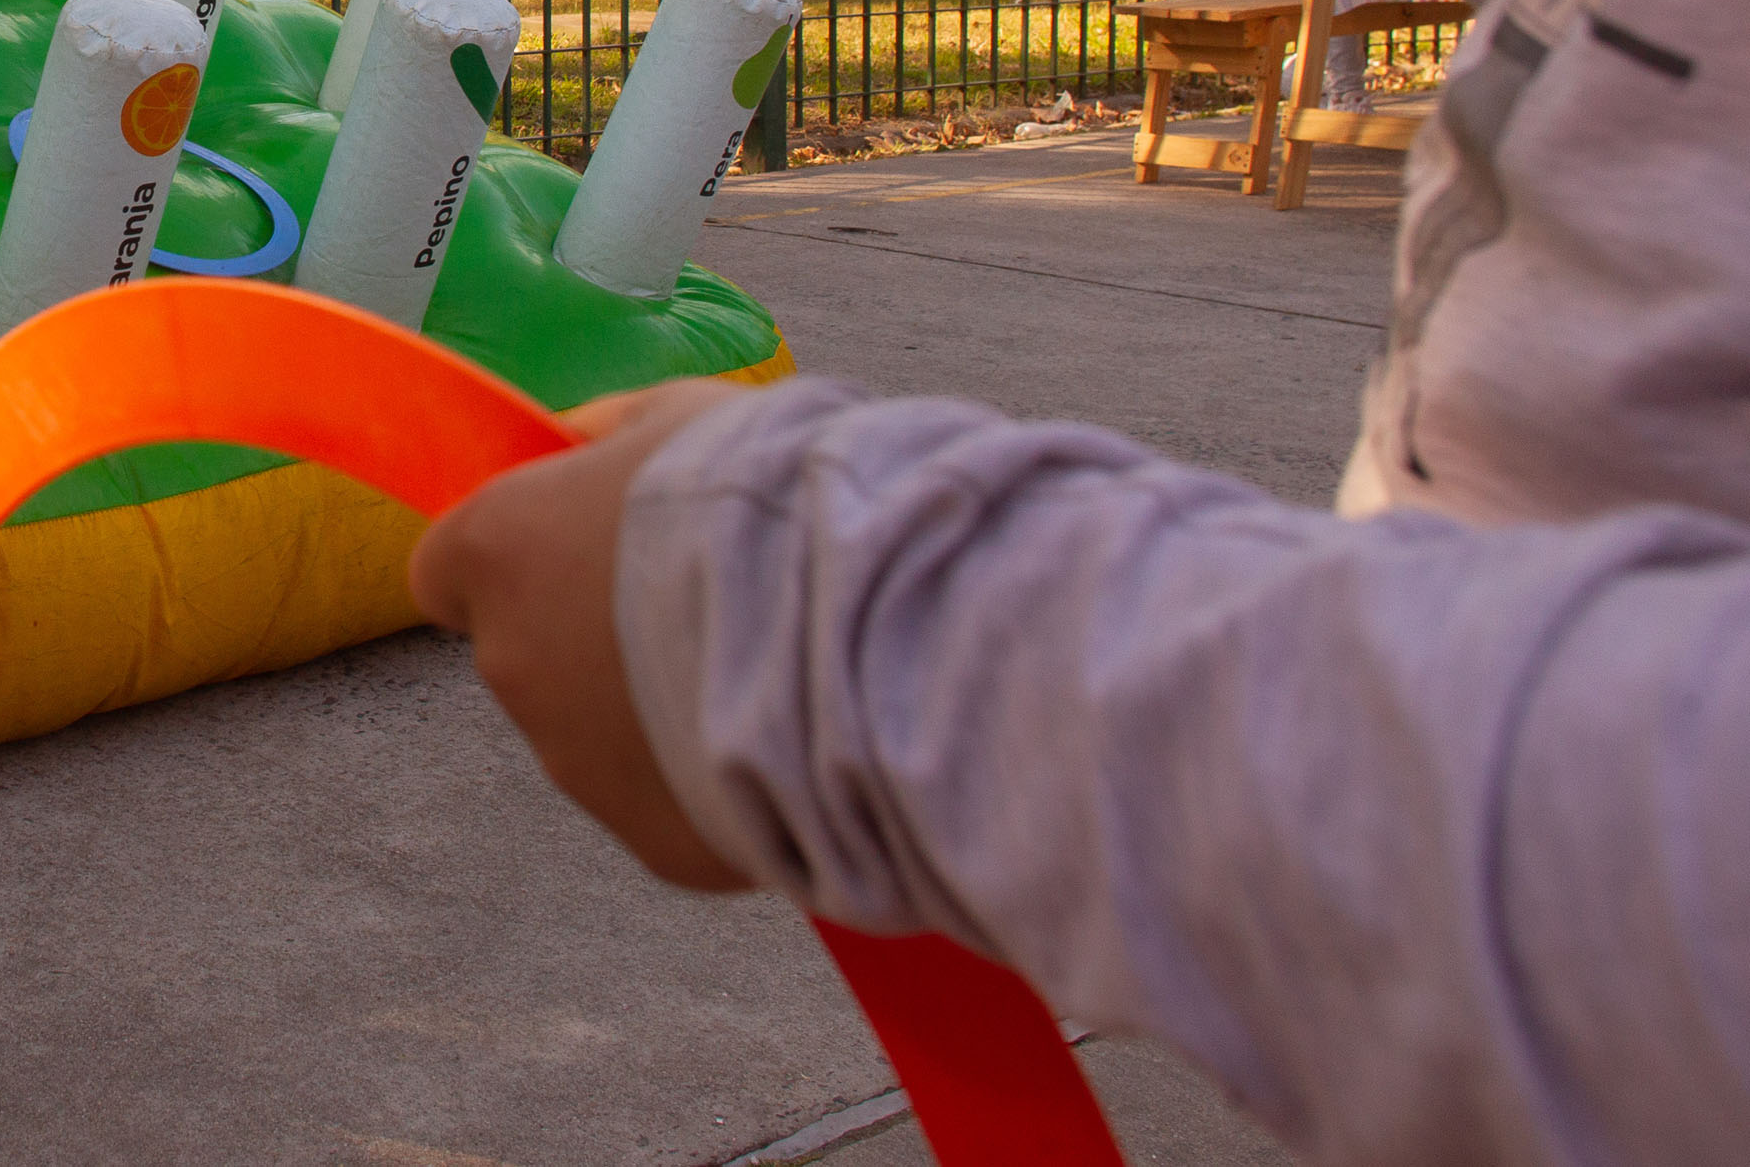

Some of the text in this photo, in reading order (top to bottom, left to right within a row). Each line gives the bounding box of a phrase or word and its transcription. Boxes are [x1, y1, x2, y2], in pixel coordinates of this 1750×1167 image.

[414, 155, 470, 268] Pepino
[699, 130, 744, 197] Pera
[109, 182, 157, 289] aranja
